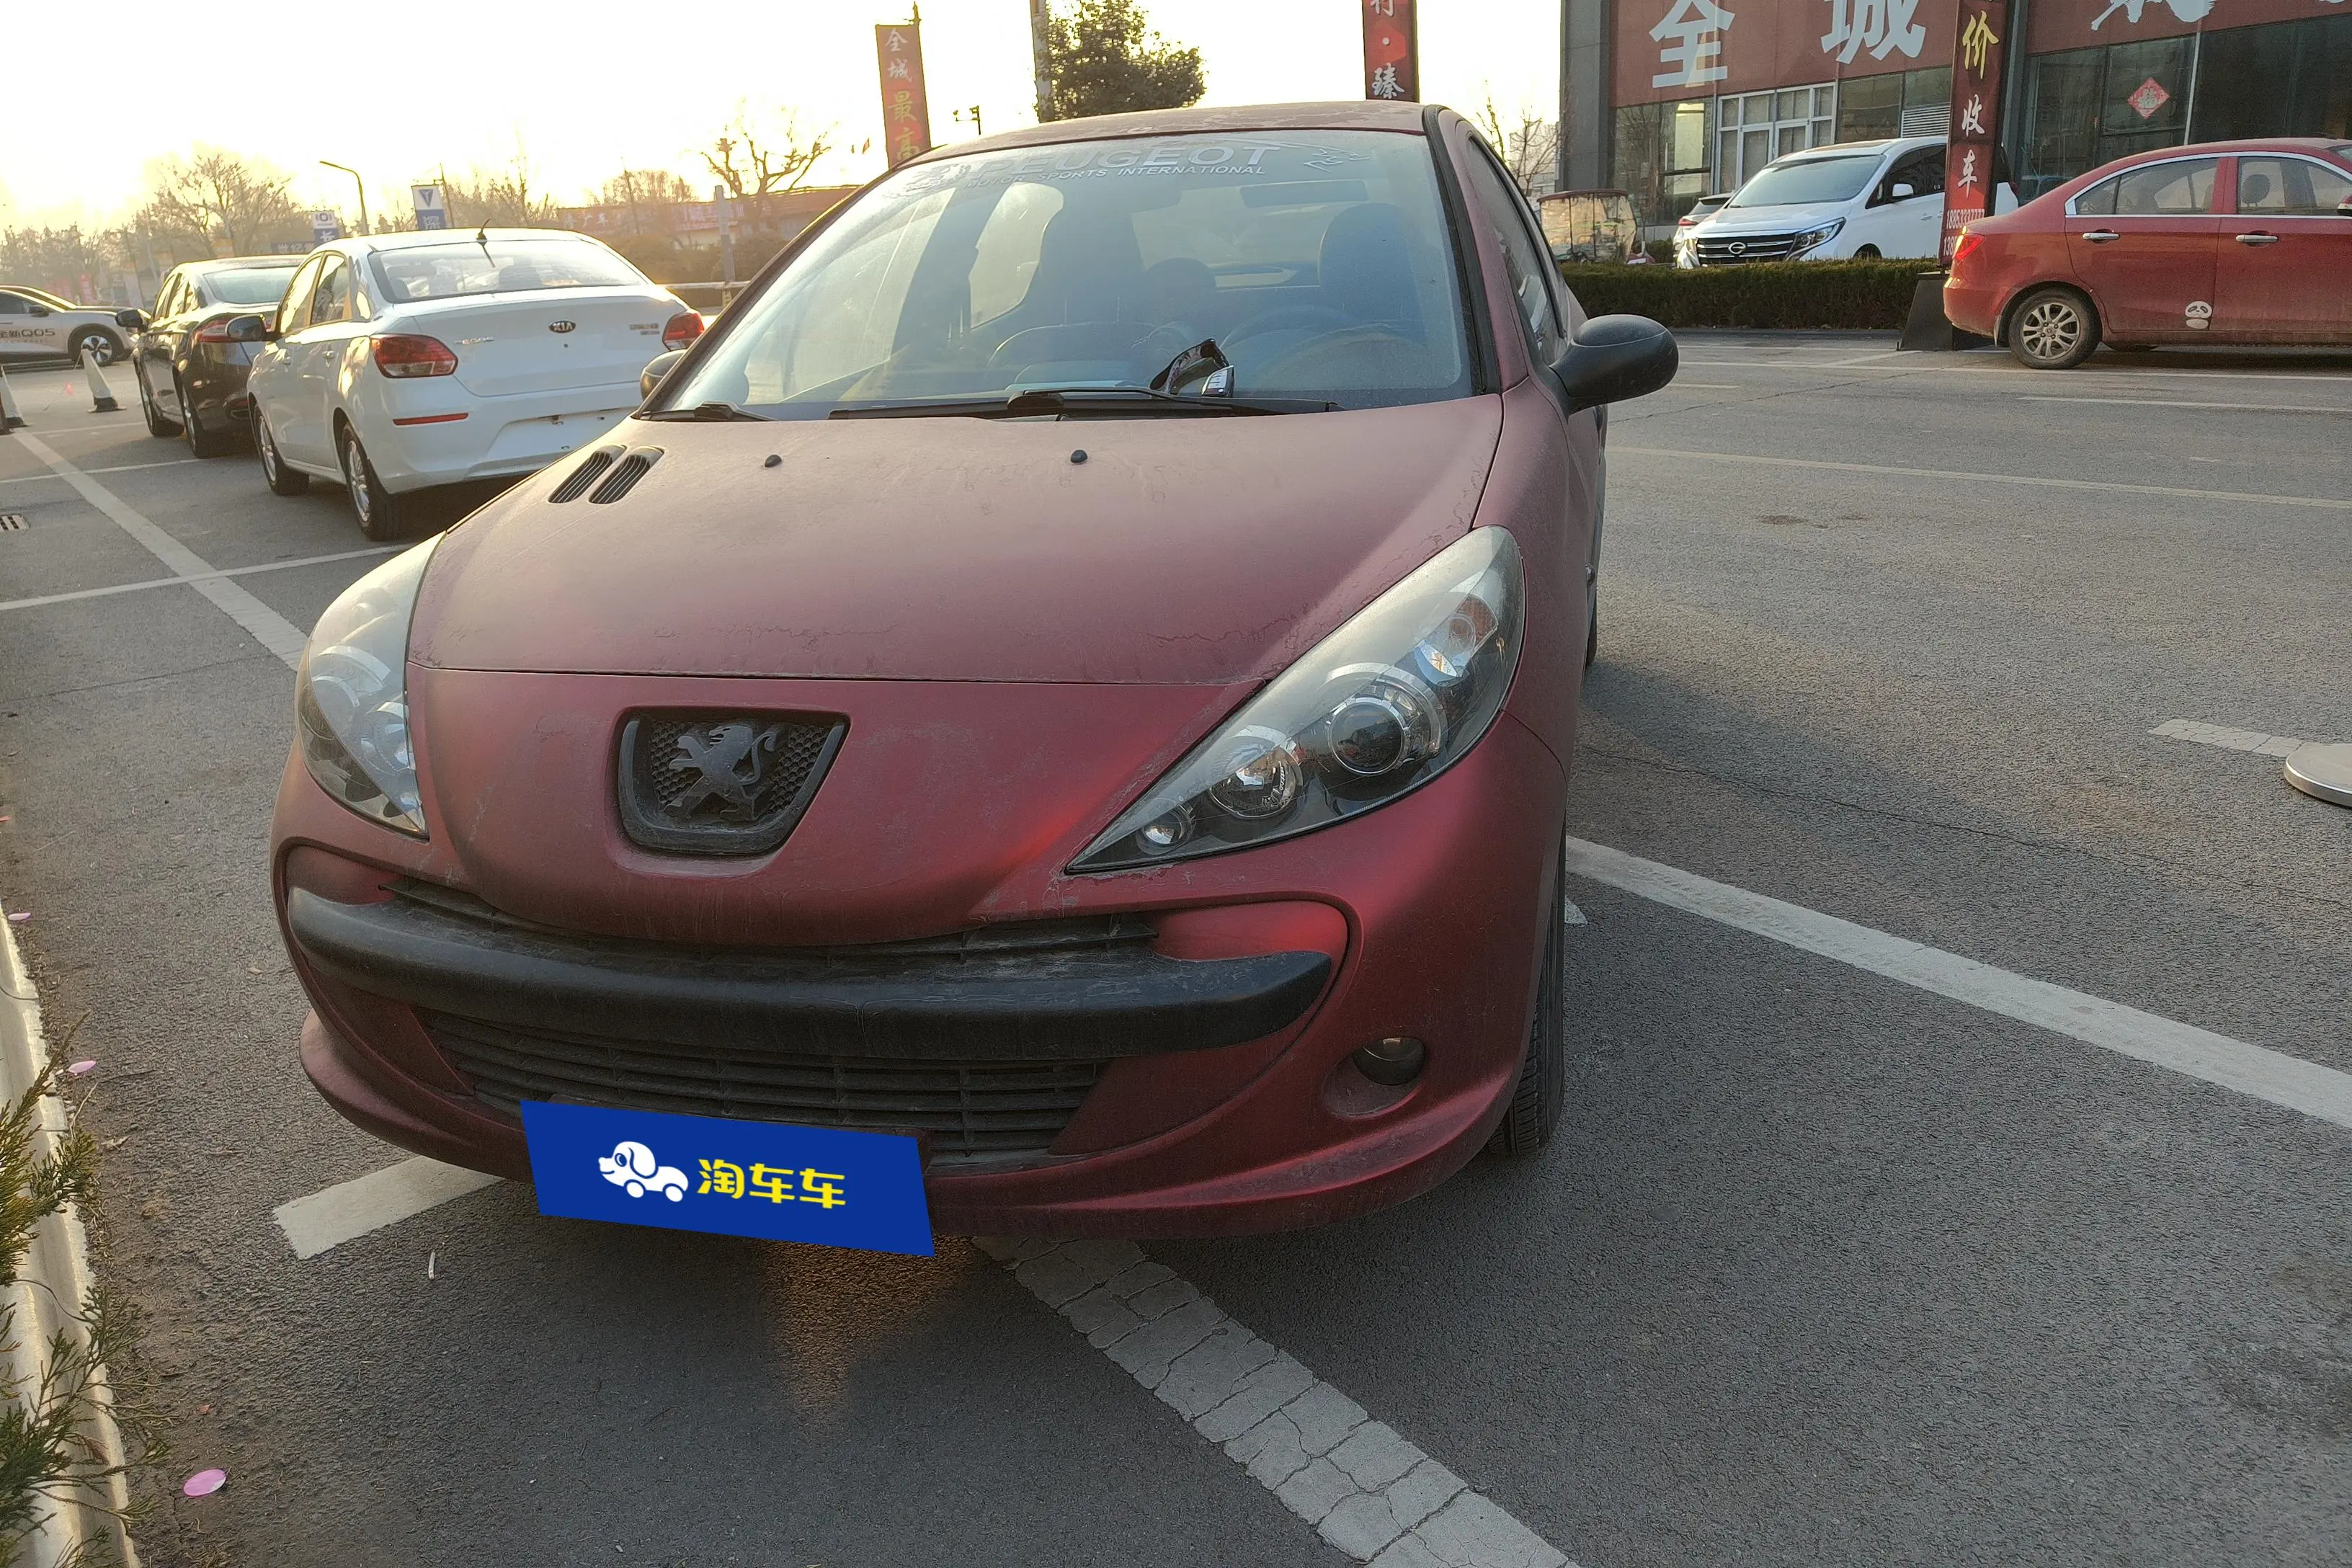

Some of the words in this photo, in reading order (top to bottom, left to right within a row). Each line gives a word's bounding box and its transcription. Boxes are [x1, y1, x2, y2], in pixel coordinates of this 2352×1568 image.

[885, 28, 920, 160] 全城最高
[971, 146, 1280, 179] PEUGEOT
[964, 174, 1025, 189] MOTOR
[1038, 169, 1108, 182] SPORTS
[1117, 165, 1266, 177] INTERNATIONAL
[553, 321, 574, 331] KIA
